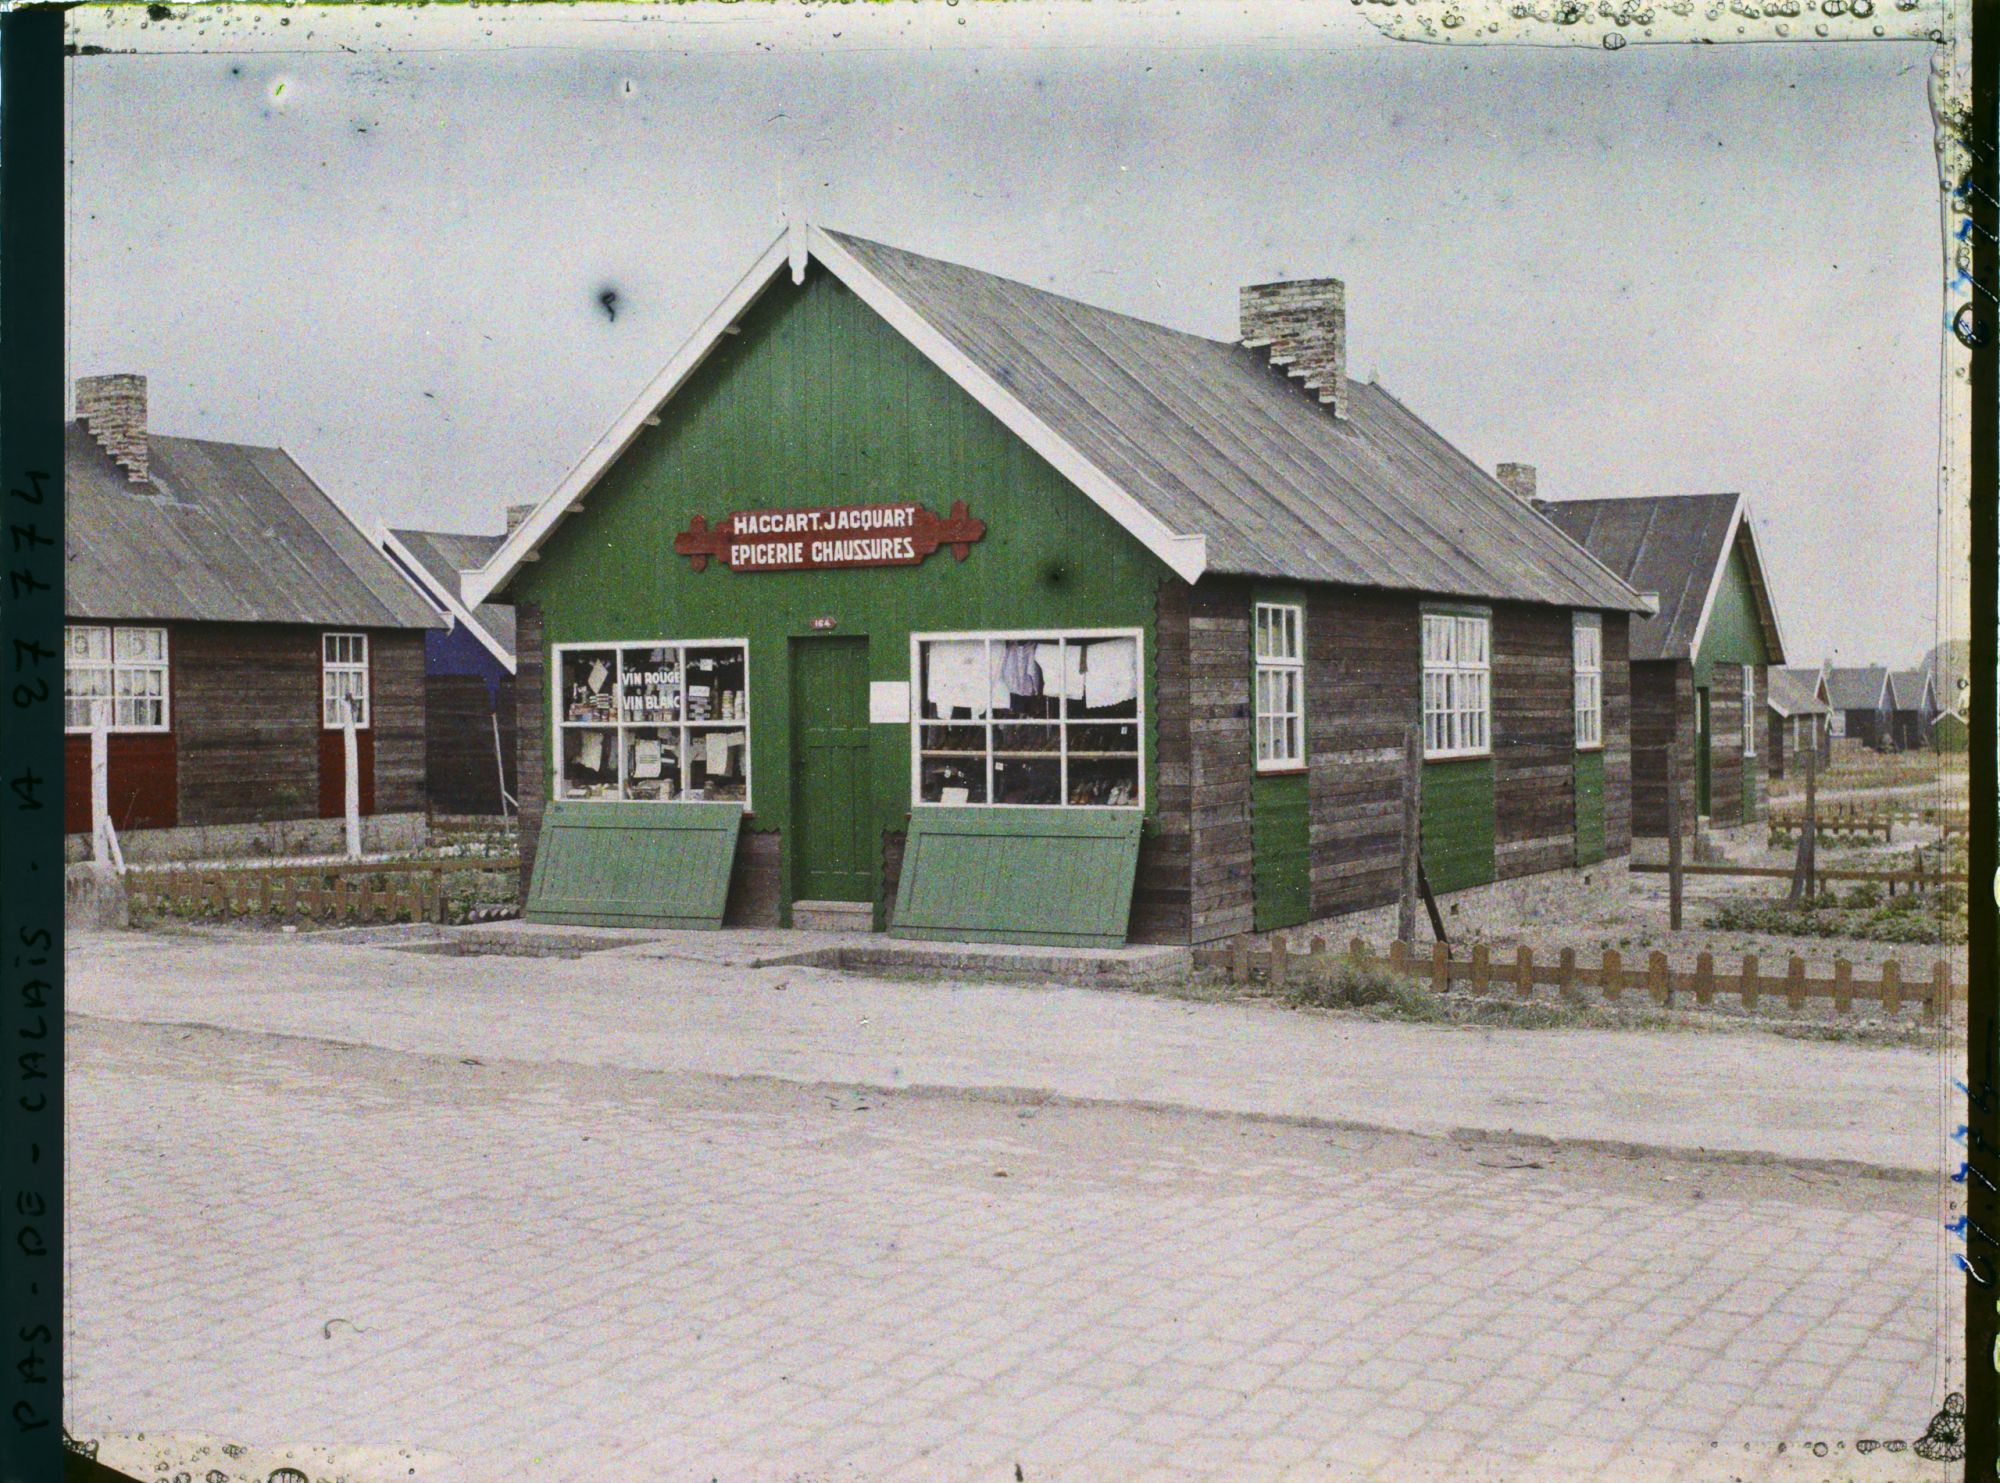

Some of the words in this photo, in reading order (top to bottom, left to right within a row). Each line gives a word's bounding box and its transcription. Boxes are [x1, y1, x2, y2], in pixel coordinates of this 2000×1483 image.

[731, 542, 804, 566] EPICERIE
[811, 537, 916, 562] CHAUSSURES
[621, 672, 642, 686] VIN
[644, 671, 681, 684] ROUGE
[623, 695, 643, 710] VIN
[645, 695, 681, 709] BLANC
